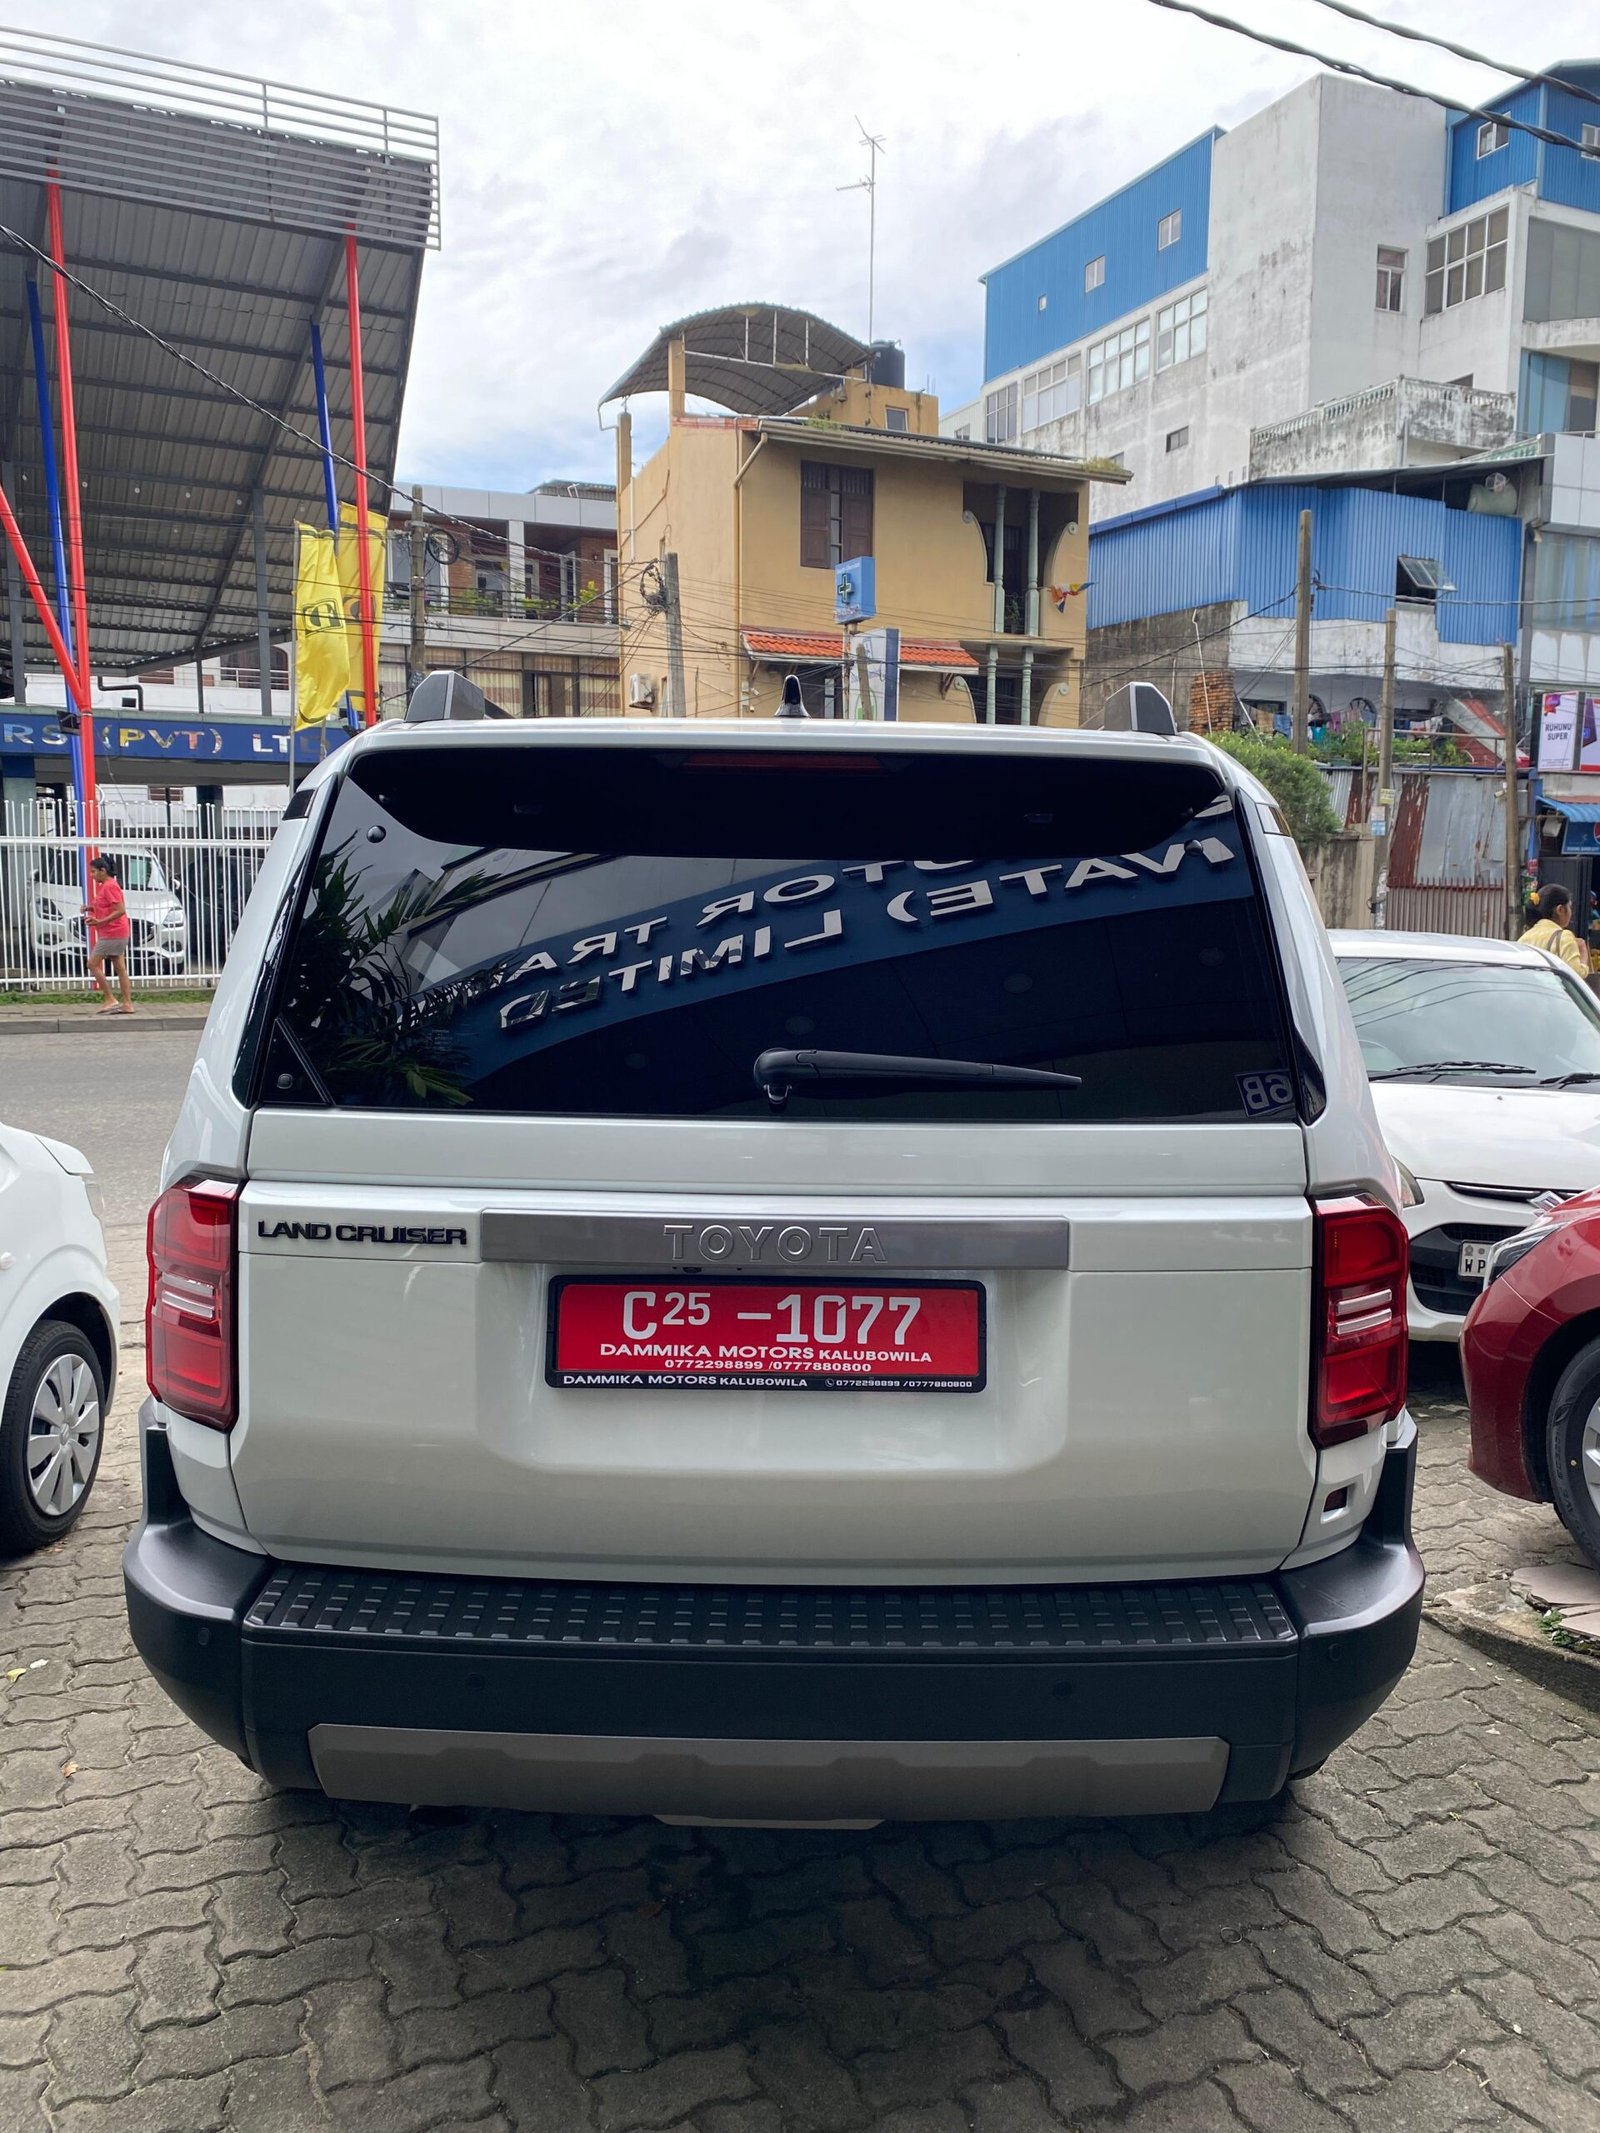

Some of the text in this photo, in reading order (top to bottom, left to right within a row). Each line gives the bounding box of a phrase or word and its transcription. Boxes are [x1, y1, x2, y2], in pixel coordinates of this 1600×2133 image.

[1545, 723, 1572, 732] RUHUNU
[103, 724, 223, 754] (PVT)
[1547, 732, 1569, 741] SUPER
[257, 1220, 467, 1245] LAND CRUISER
[663, 1224, 888, 1263] TOYOTA
[600, 1343, 932, 1363] DAMMIKA MOTORS KALUBOWILA
[664, 1359, 764, 1369] 0772298899
[563, 1374, 644, 1385] DAMMIKA
[648, 1375, 717, 1385] MOTORS
[719, 1377, 808, 1387] KALUBOWILA
